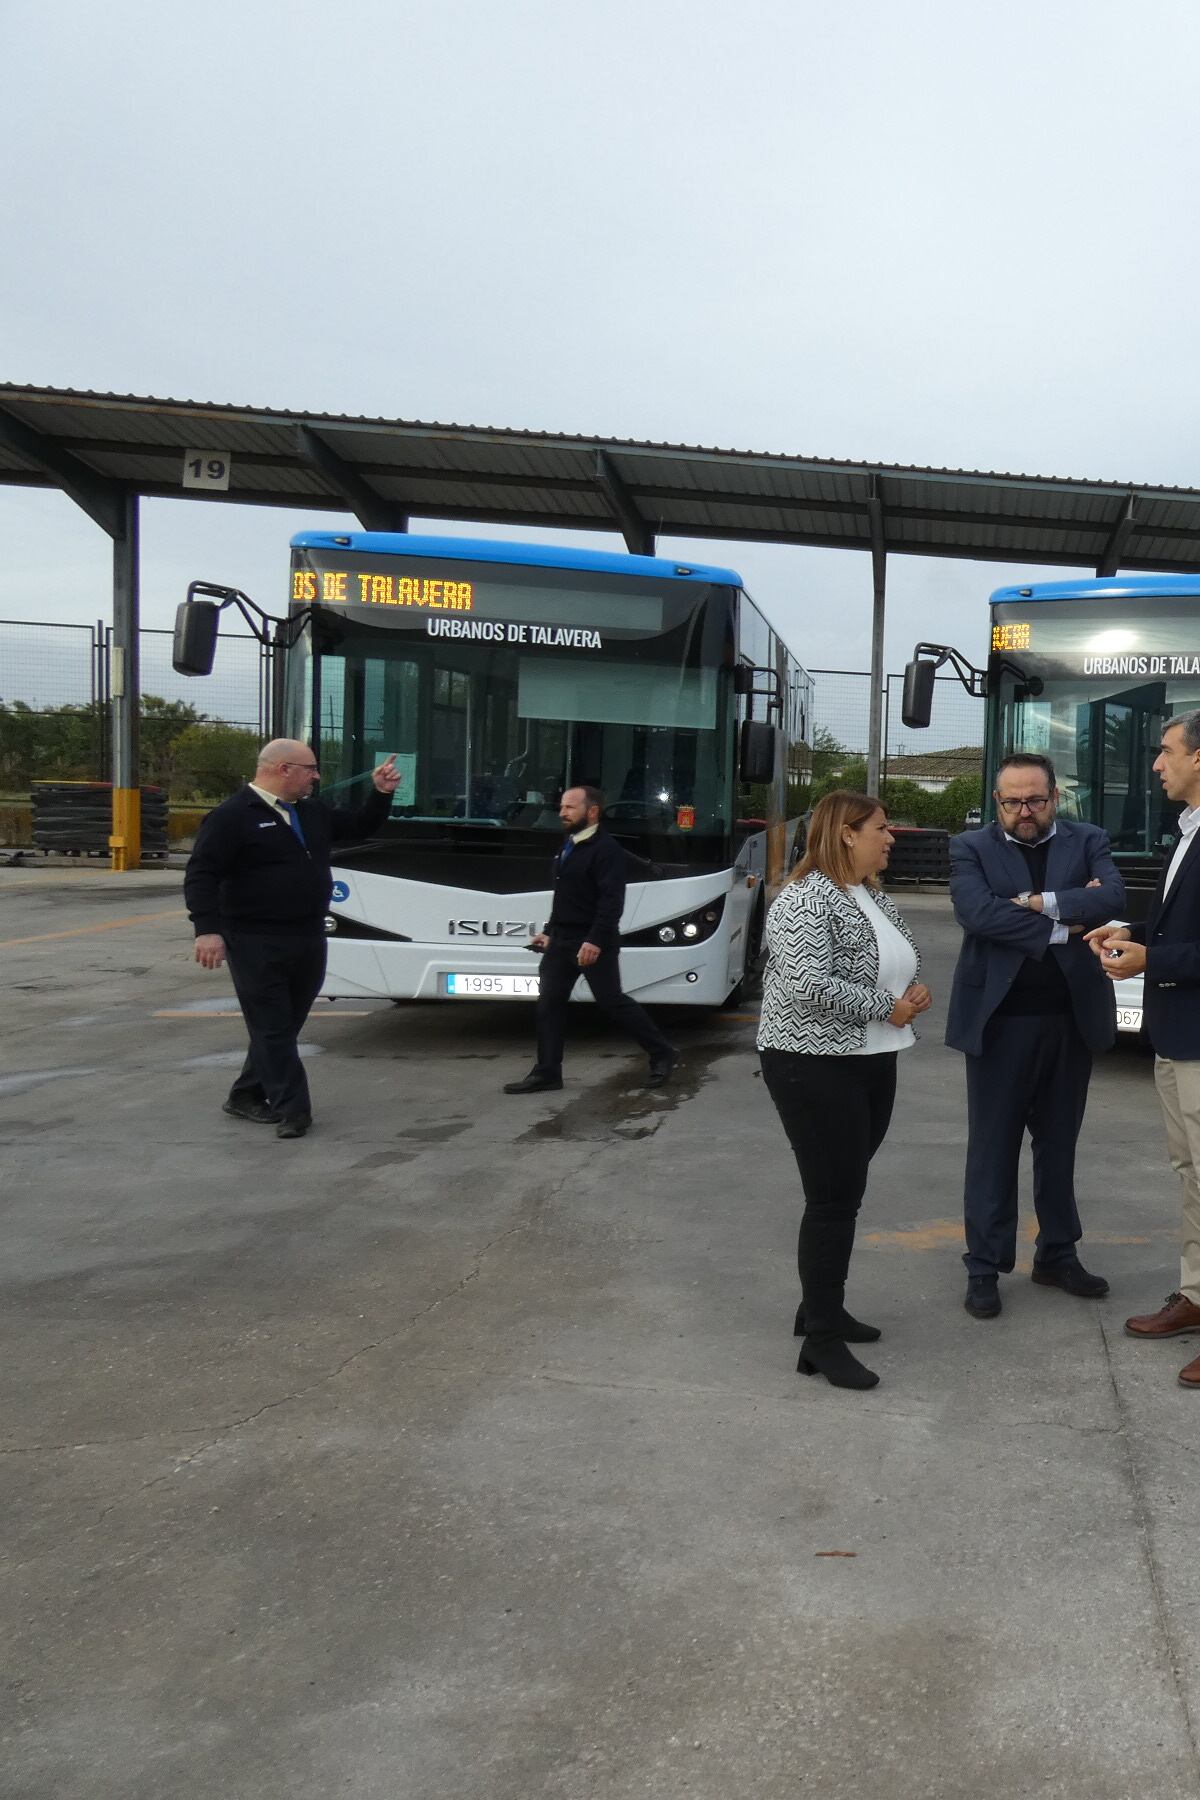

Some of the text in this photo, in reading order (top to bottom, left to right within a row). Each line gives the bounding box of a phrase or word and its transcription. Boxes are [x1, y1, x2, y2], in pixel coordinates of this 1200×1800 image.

[188, 458, 226, 480] 19
[322, 572, 348, 601] DE
[357, 574, 473, 611] TALAVERA
[427, 617, 603, 649] URBANOS DE TALAVERA
[992, 623, 1031, 651] VERA
[1083, 656, 1148, 675] URBANOS
[1150, 656, 1168, 674] DE
[448, 919, 549, 938] ISUZU
[464, 977, 504, 992] 1995
